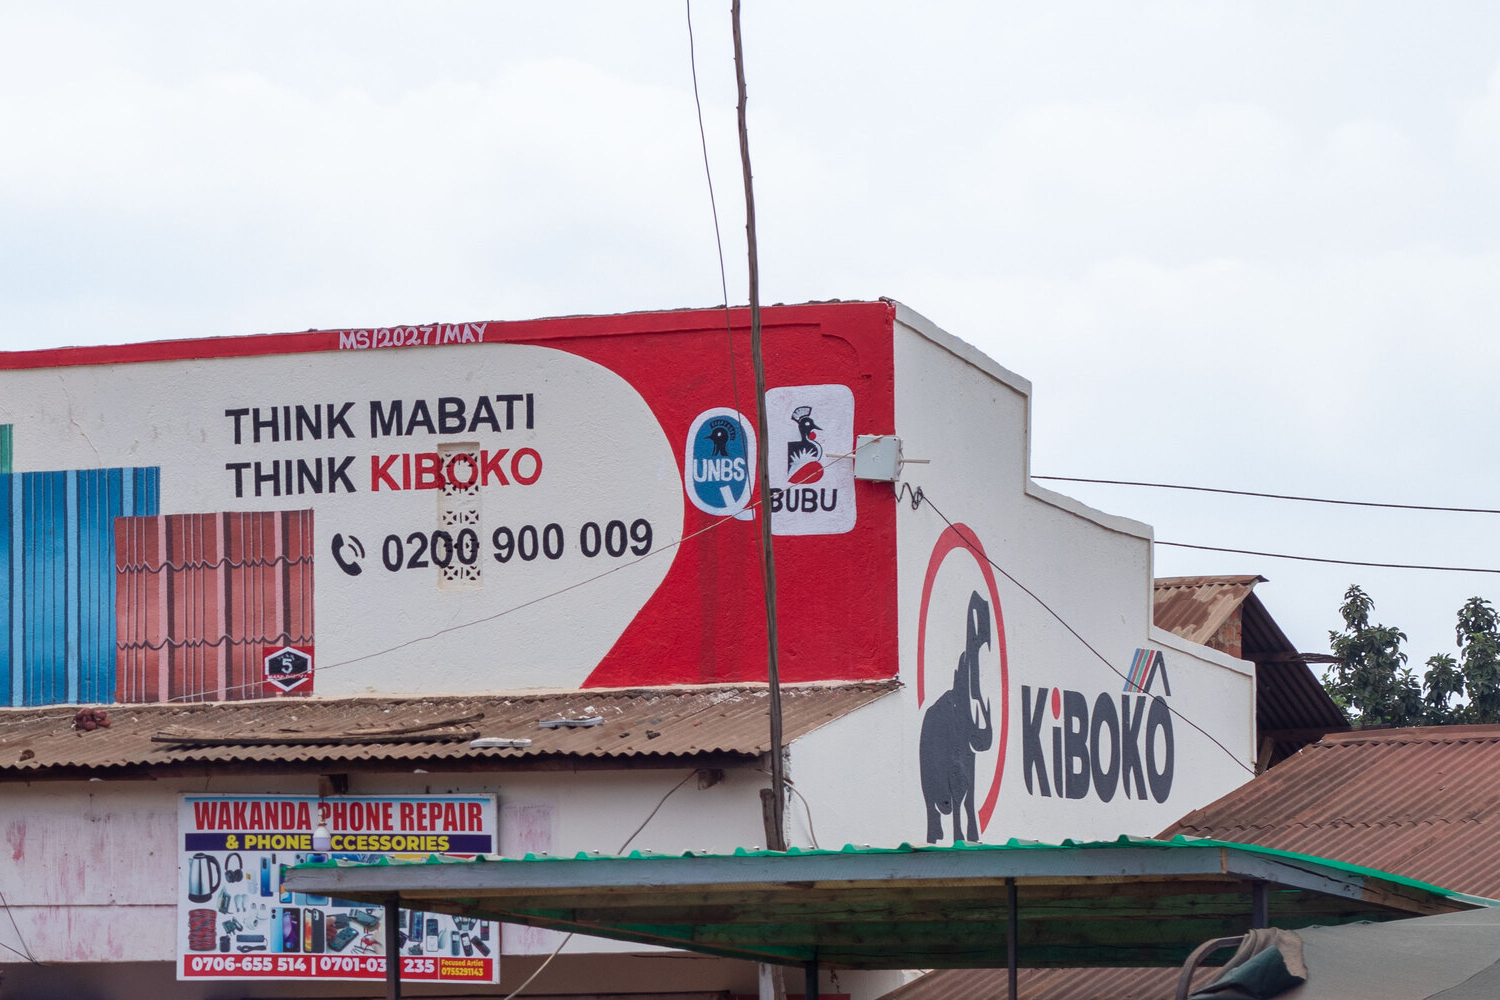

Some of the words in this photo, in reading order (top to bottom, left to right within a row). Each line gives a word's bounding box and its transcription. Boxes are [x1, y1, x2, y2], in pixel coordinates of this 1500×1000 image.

[225, 402, 356, 444] THINK
[369, 393, 535, 437] MABATI
[225, 455, 356, 498] THINK
[370, 447, 543, 492] KIBOKO
[693, 457, 746, 482] UNBS
[769, 488, 837, 513] BUBU
[382, 529, 479, 573] 0200
[493, 523, 564, 563] 900
[580, 518, 653, 558] 009
[281, 658, 293, 674] 5
[194, 801, 311, 830] WAKANDA
[317, 801, 393, 831] PHONE
[400, 802, 483, 832] REPAIR
[226, 835, 239, 850] &
[245, 834, 311, 850] PHONE
[331, 835, 449, 851] CCESSORIES
[192, 956, 272, 971] 0706-655
[277, 957, 306, 971] 514
[320, 957, 387, 972] 0701-03
[404, 959, 434, 973] 235
[441, 959, 465, 967] Focused
[466, 959, 484, 967] Artist
